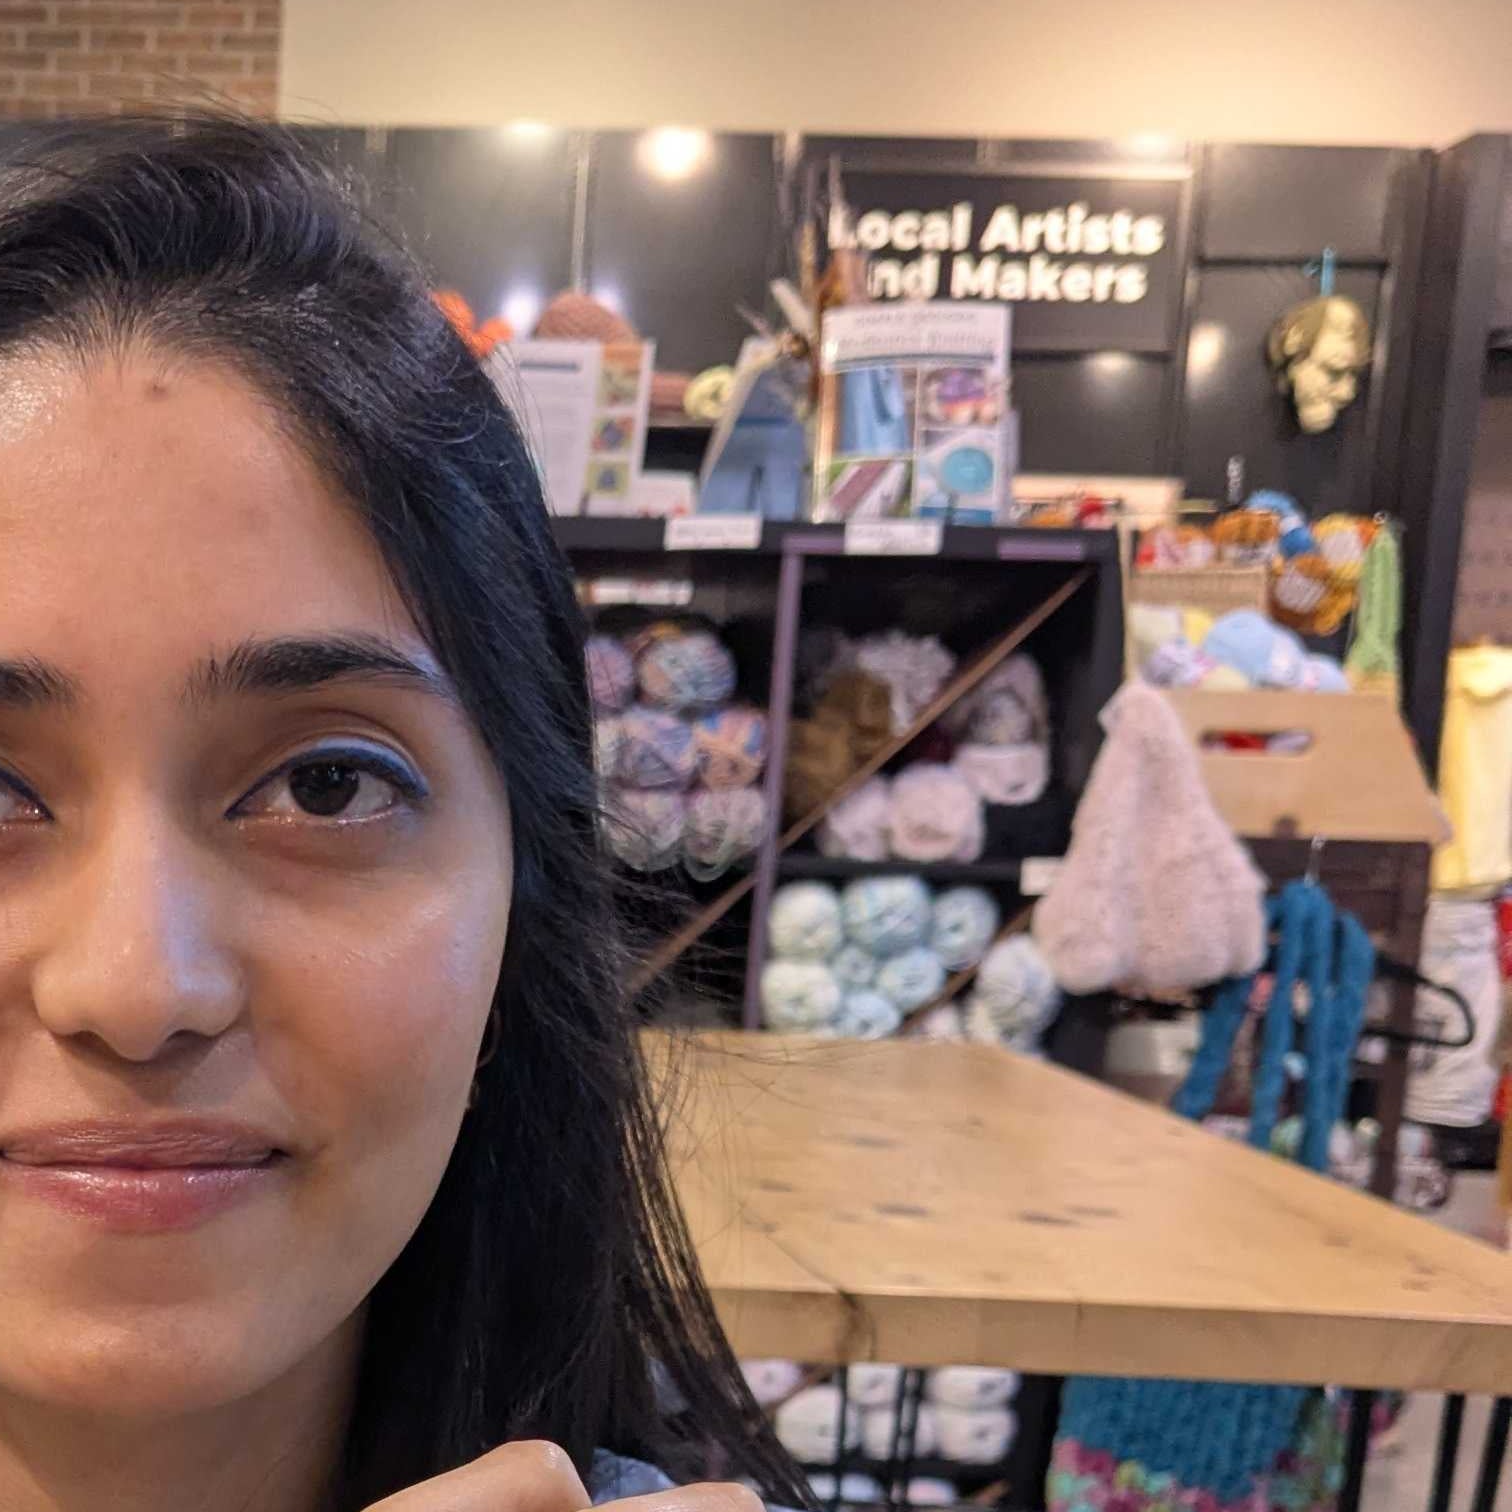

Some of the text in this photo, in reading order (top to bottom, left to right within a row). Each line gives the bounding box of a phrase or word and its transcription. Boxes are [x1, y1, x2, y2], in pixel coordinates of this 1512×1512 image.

[827, 201, 1165, 256] Local Artists
[867, 250, 1148, 303] nd Makers
